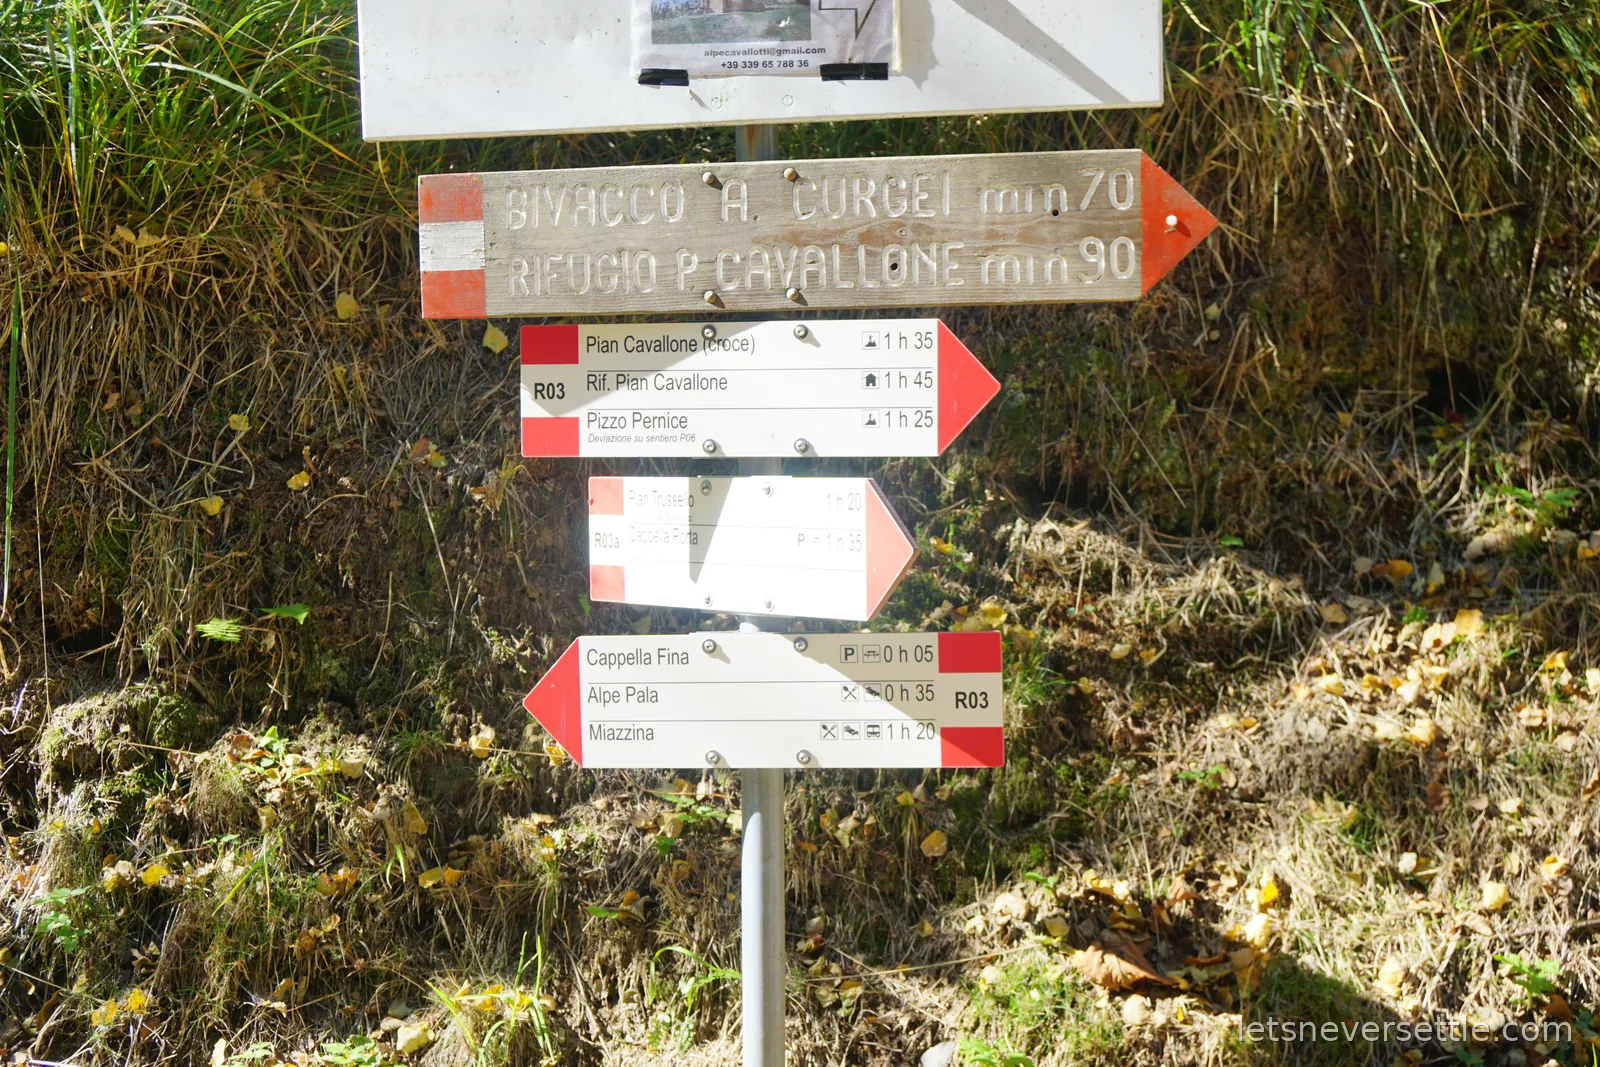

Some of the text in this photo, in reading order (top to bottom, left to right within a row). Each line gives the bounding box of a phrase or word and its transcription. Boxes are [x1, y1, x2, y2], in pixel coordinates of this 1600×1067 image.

[704, 46, 826, 57] alpecavallotti@gmail.com
[721, 59, 809, 69] +39 339 65 788 36
[506, 180, 685, 229] BIVACCO
[792, 171, 950, 221] CURGEI
[979, 183, 1069, 214] min
[1080, 167, 1134, 211] 70
[507, 249, 656, 296] RIFUGIO
[716, 241, 965, 292] CAVALLONE
[979, 252, 1068, 285] min
[1077, 236, 1136, 284] 90
[586, 333, 756, 356] Pian Cavallone (croce)
[884, 332, 933, 350] 1 h 35
[586, 372, 728, 391] Rif. Pian Cavallone
[884, 371, 933, 389] 1 h 45
[533, 382, 566, 400] R03
[587, 411, 688, 429] Pizzo Pernice
[884, 410, 933, 428] 1 h 25
[588, 433, 696, 443] Deviazione su sentiero P06
[628, 489, 695, 508] Pian Trussello
[826, 492, 863, 511] 1 h 20
[595, 532, 620, 548] R03a
[628, 525, 698, 545] Cappella Porta
[826, 534, 832, 551] 1
[837, 534, 844, 551] h
[848, 534, 863, 552] 35
[586, 648, 690, 669] Cappella Fina
[843, 645, 933, 663] P 0 h 05
[587, 686, 659, 706] Alpe Pala
[884, 684, 935, 702] 0 h 35
[955, 691, 989, 709] R03
[589, 724, 655, 741] Miazzina
[886, 723, 936, 740] 1 h 20
